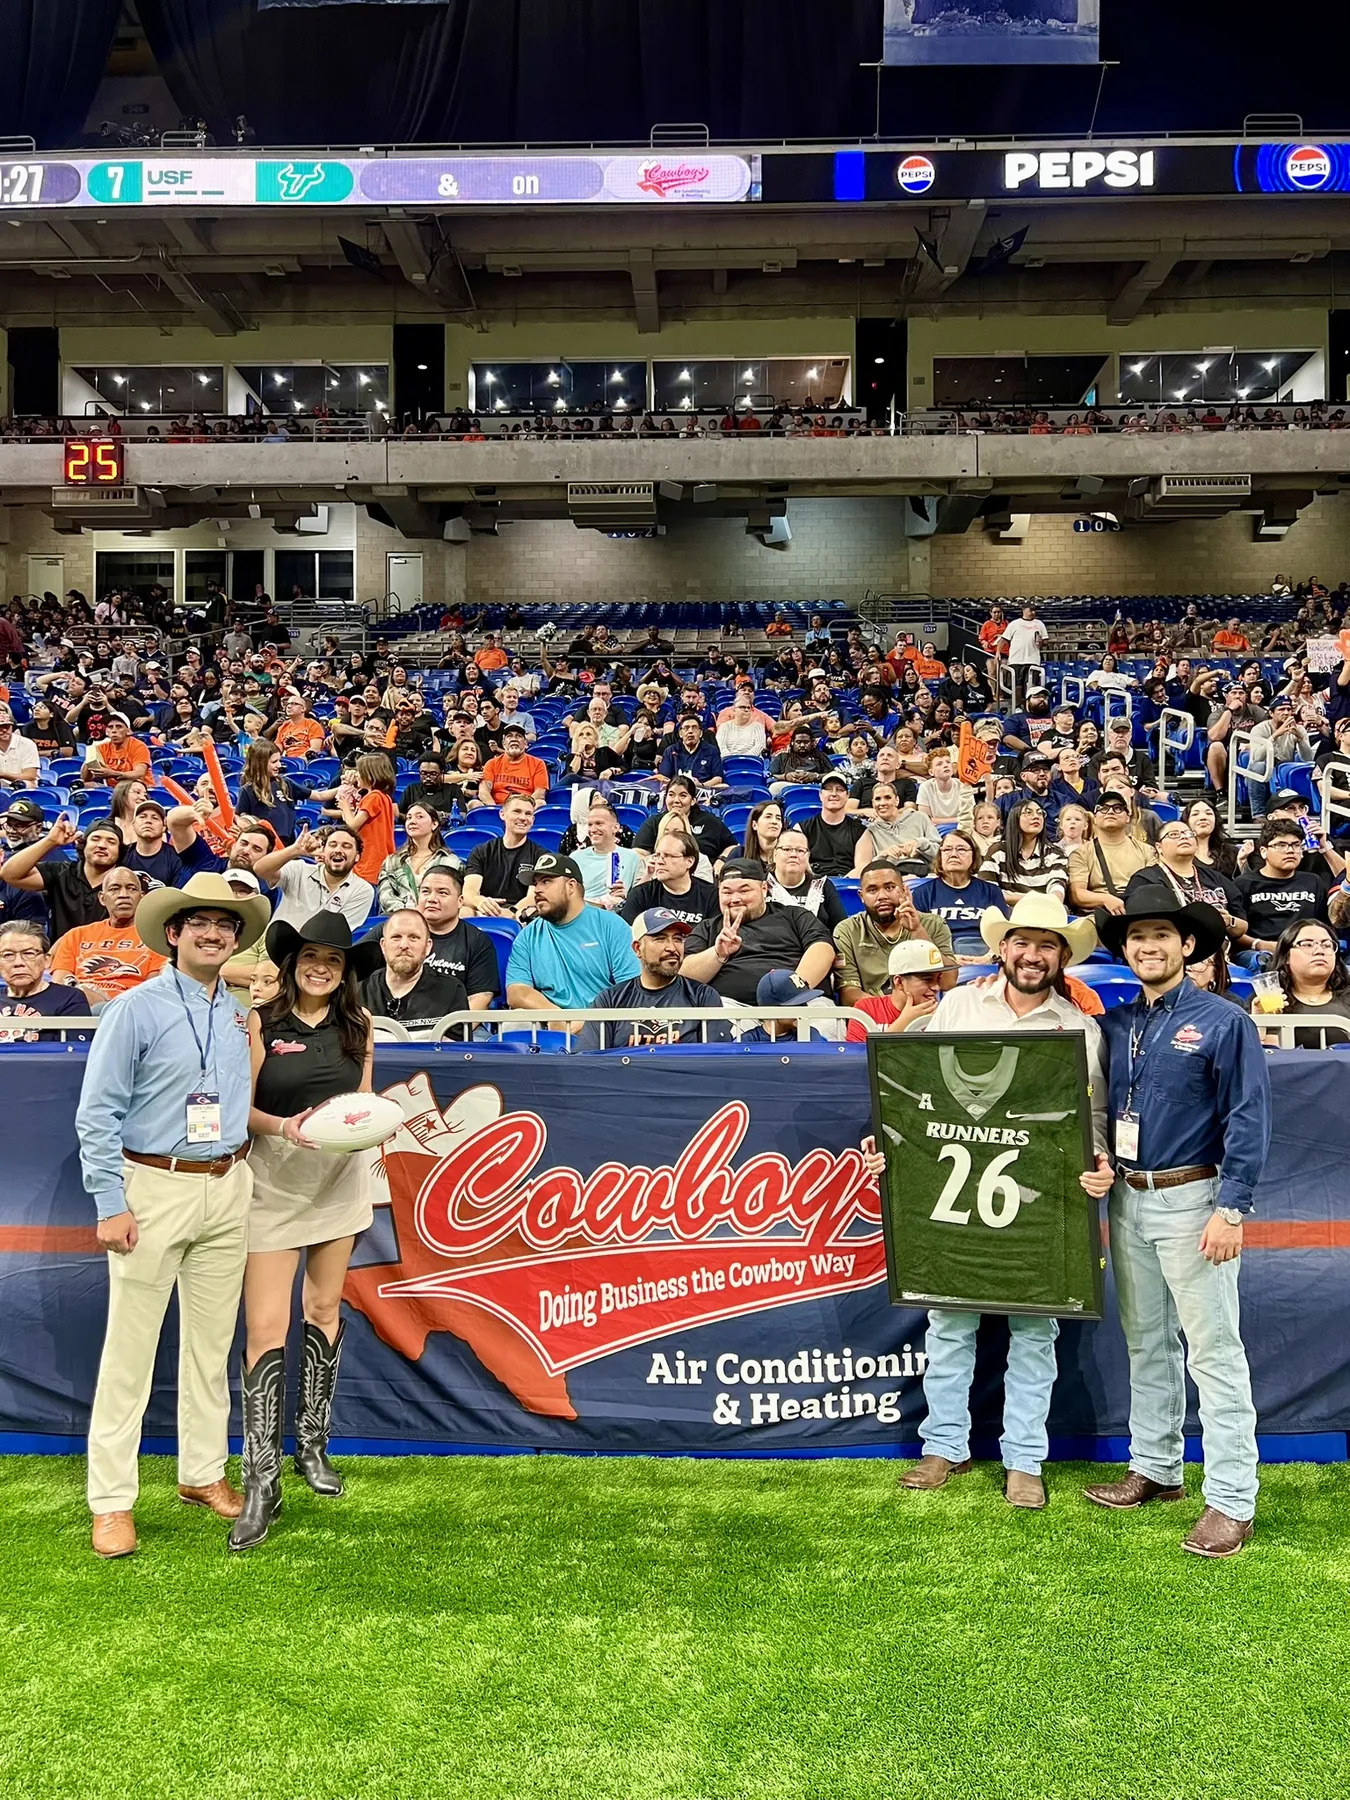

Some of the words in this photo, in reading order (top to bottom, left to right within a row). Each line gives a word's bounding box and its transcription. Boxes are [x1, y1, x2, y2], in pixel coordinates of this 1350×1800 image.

[0, 165, 43, 202] :27
[107, 166, 123, 199] 7
[147, 170, 192, 186] USF
[648, 163, 709, 182] Cowboys
[901, 171, 932, 179] PEPSI
[1005, 150, 1154, 188] PEPSI
[1290, 163, 1327, 172] PEPSI
[437, 173, 459, 197] &
[512, 174, 539, 195] on
[68, 444, 118, 480] 25
[1251, 891, 1316, 904] RUNNERS
[675, 909, 703, 924] NERS
[926, 1121, 1030, 1146] RUNNERS
[414, 1100, 885, 1258] Cowboys
[929, 1143, 1021, 1228] 26
[539, 1284, 597, 1332] Doing
[600, 1277, 690, 1315] Business
[691, 1267, 726, 1294] the
[728, 1258, 808, 1287] Cowboy
[809, 1253, 857, 1277] Way
[646, 1350, 707, 1385] Air
[711, 1392, 742, 1425] &
[750, 1386, 902, 1425] Heating
